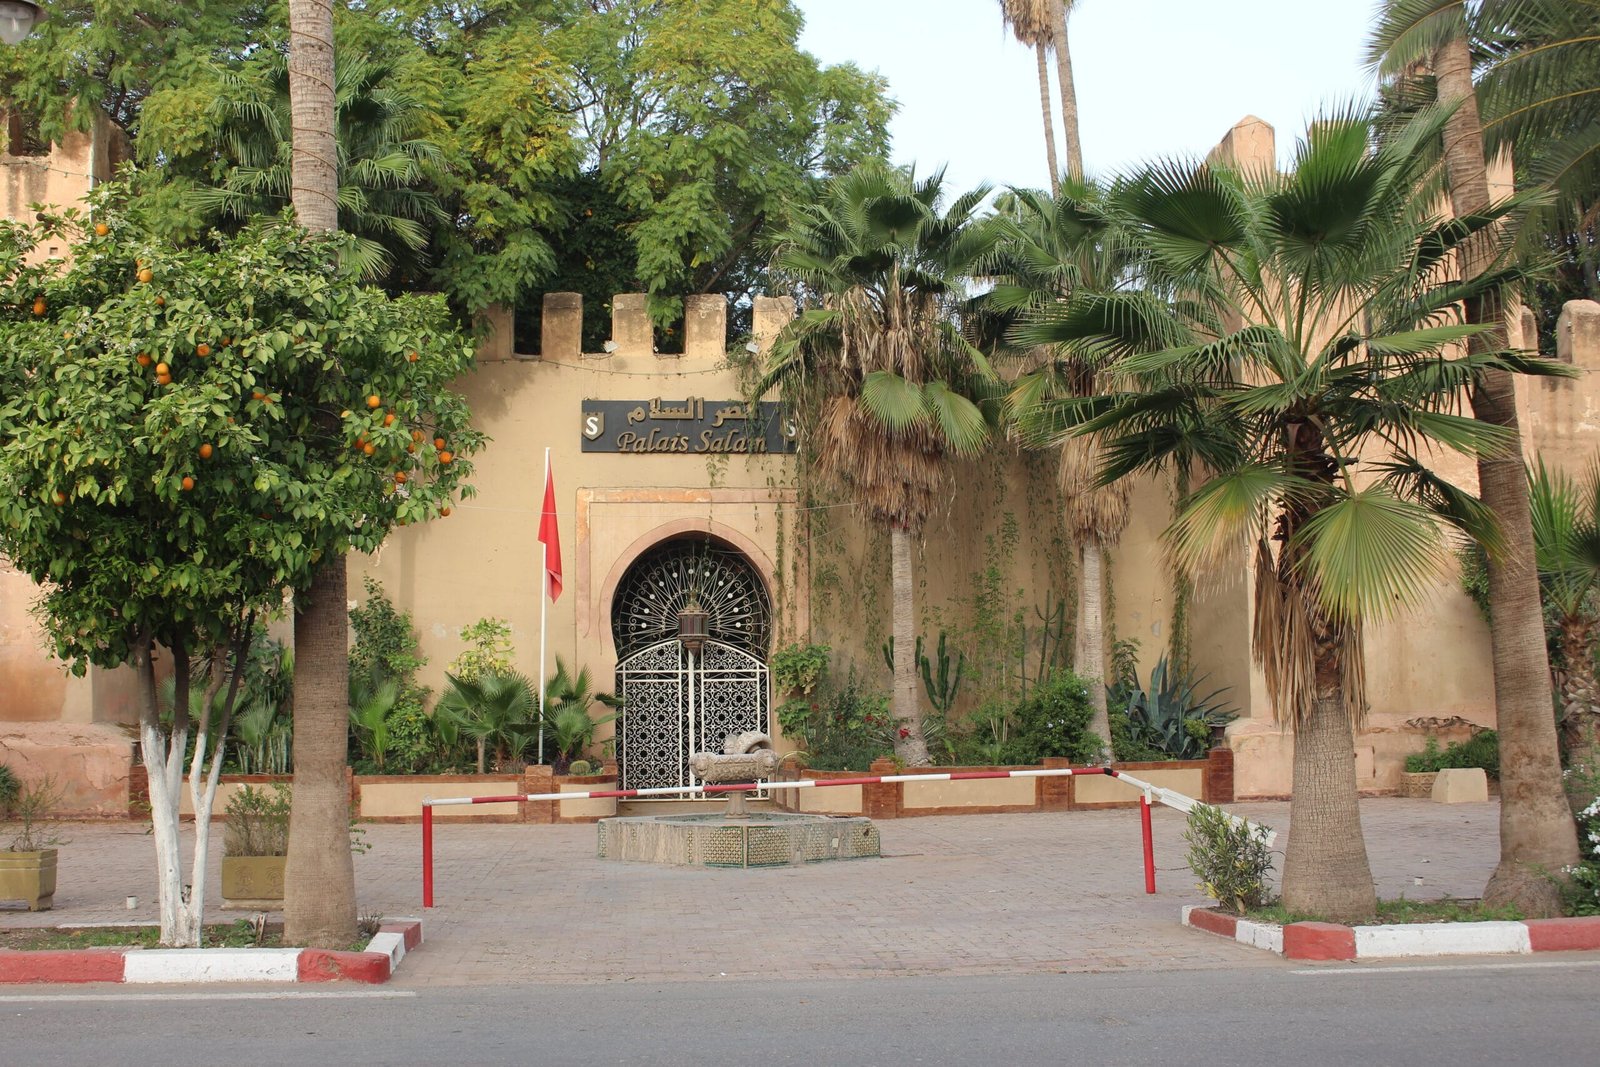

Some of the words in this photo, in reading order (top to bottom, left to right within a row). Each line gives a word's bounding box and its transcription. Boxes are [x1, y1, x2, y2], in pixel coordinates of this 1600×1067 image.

[627, 396, 704, 425] السلام
[585, 416, 599, 436] S
[616, 427, 690, 453] Palais
[694, 428, 768, 453] Salam
